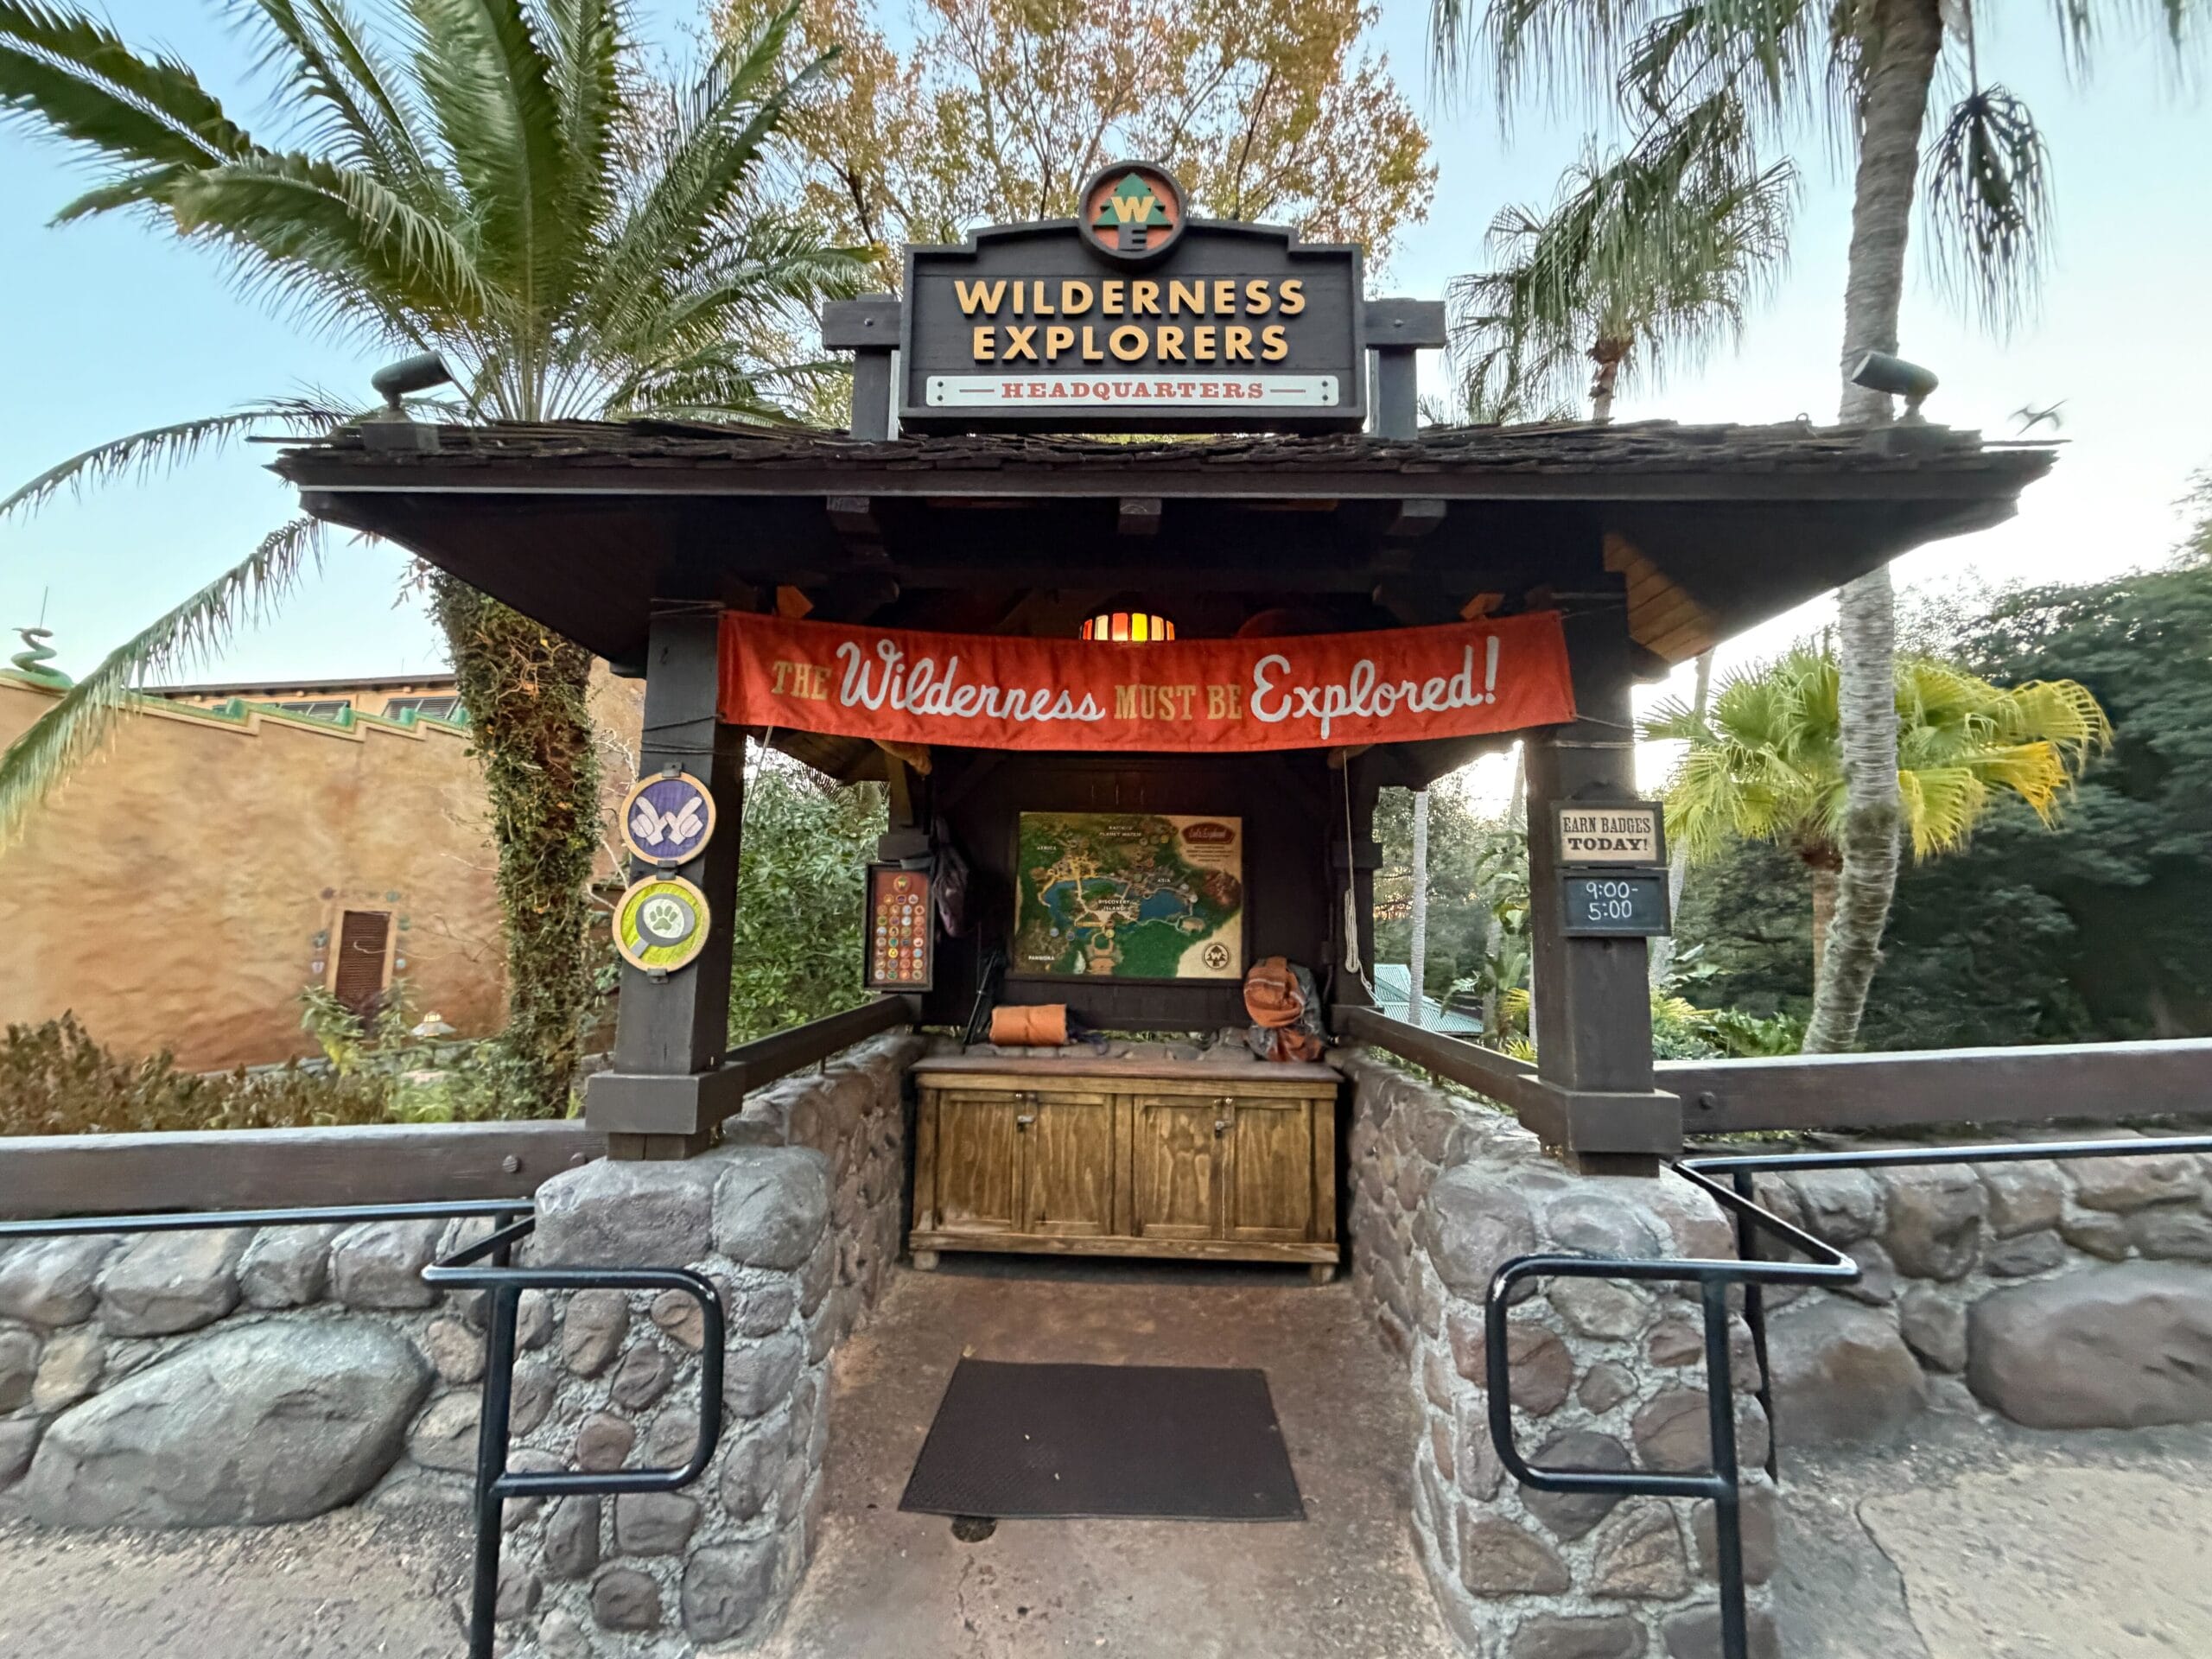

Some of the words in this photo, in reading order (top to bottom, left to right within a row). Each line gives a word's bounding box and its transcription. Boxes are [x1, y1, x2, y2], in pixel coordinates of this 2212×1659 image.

[1110, 195, 1155, 223] W
[954, 279, 1306, 316] WILDERNESS
[973, 324, 1289, 361] EXPLORERS
[1001, 382, 1264, 400] HEADQUARTERS
[771, 659, 833, 701] THE
[836, 639, 1106, 722] Wilderness
[1113, 685, 1197, 721] MUST
[1207, 683, 1243, 721] BE
[1250, 635, 1499, 741] Explored!
[1562, 817, 1597, 834] EARN
[1600, 817, 1652, 834] BADGES
[1567, 837, 1649, 851] TODAY!
[1587, 899, 1633, 921] 5:00
